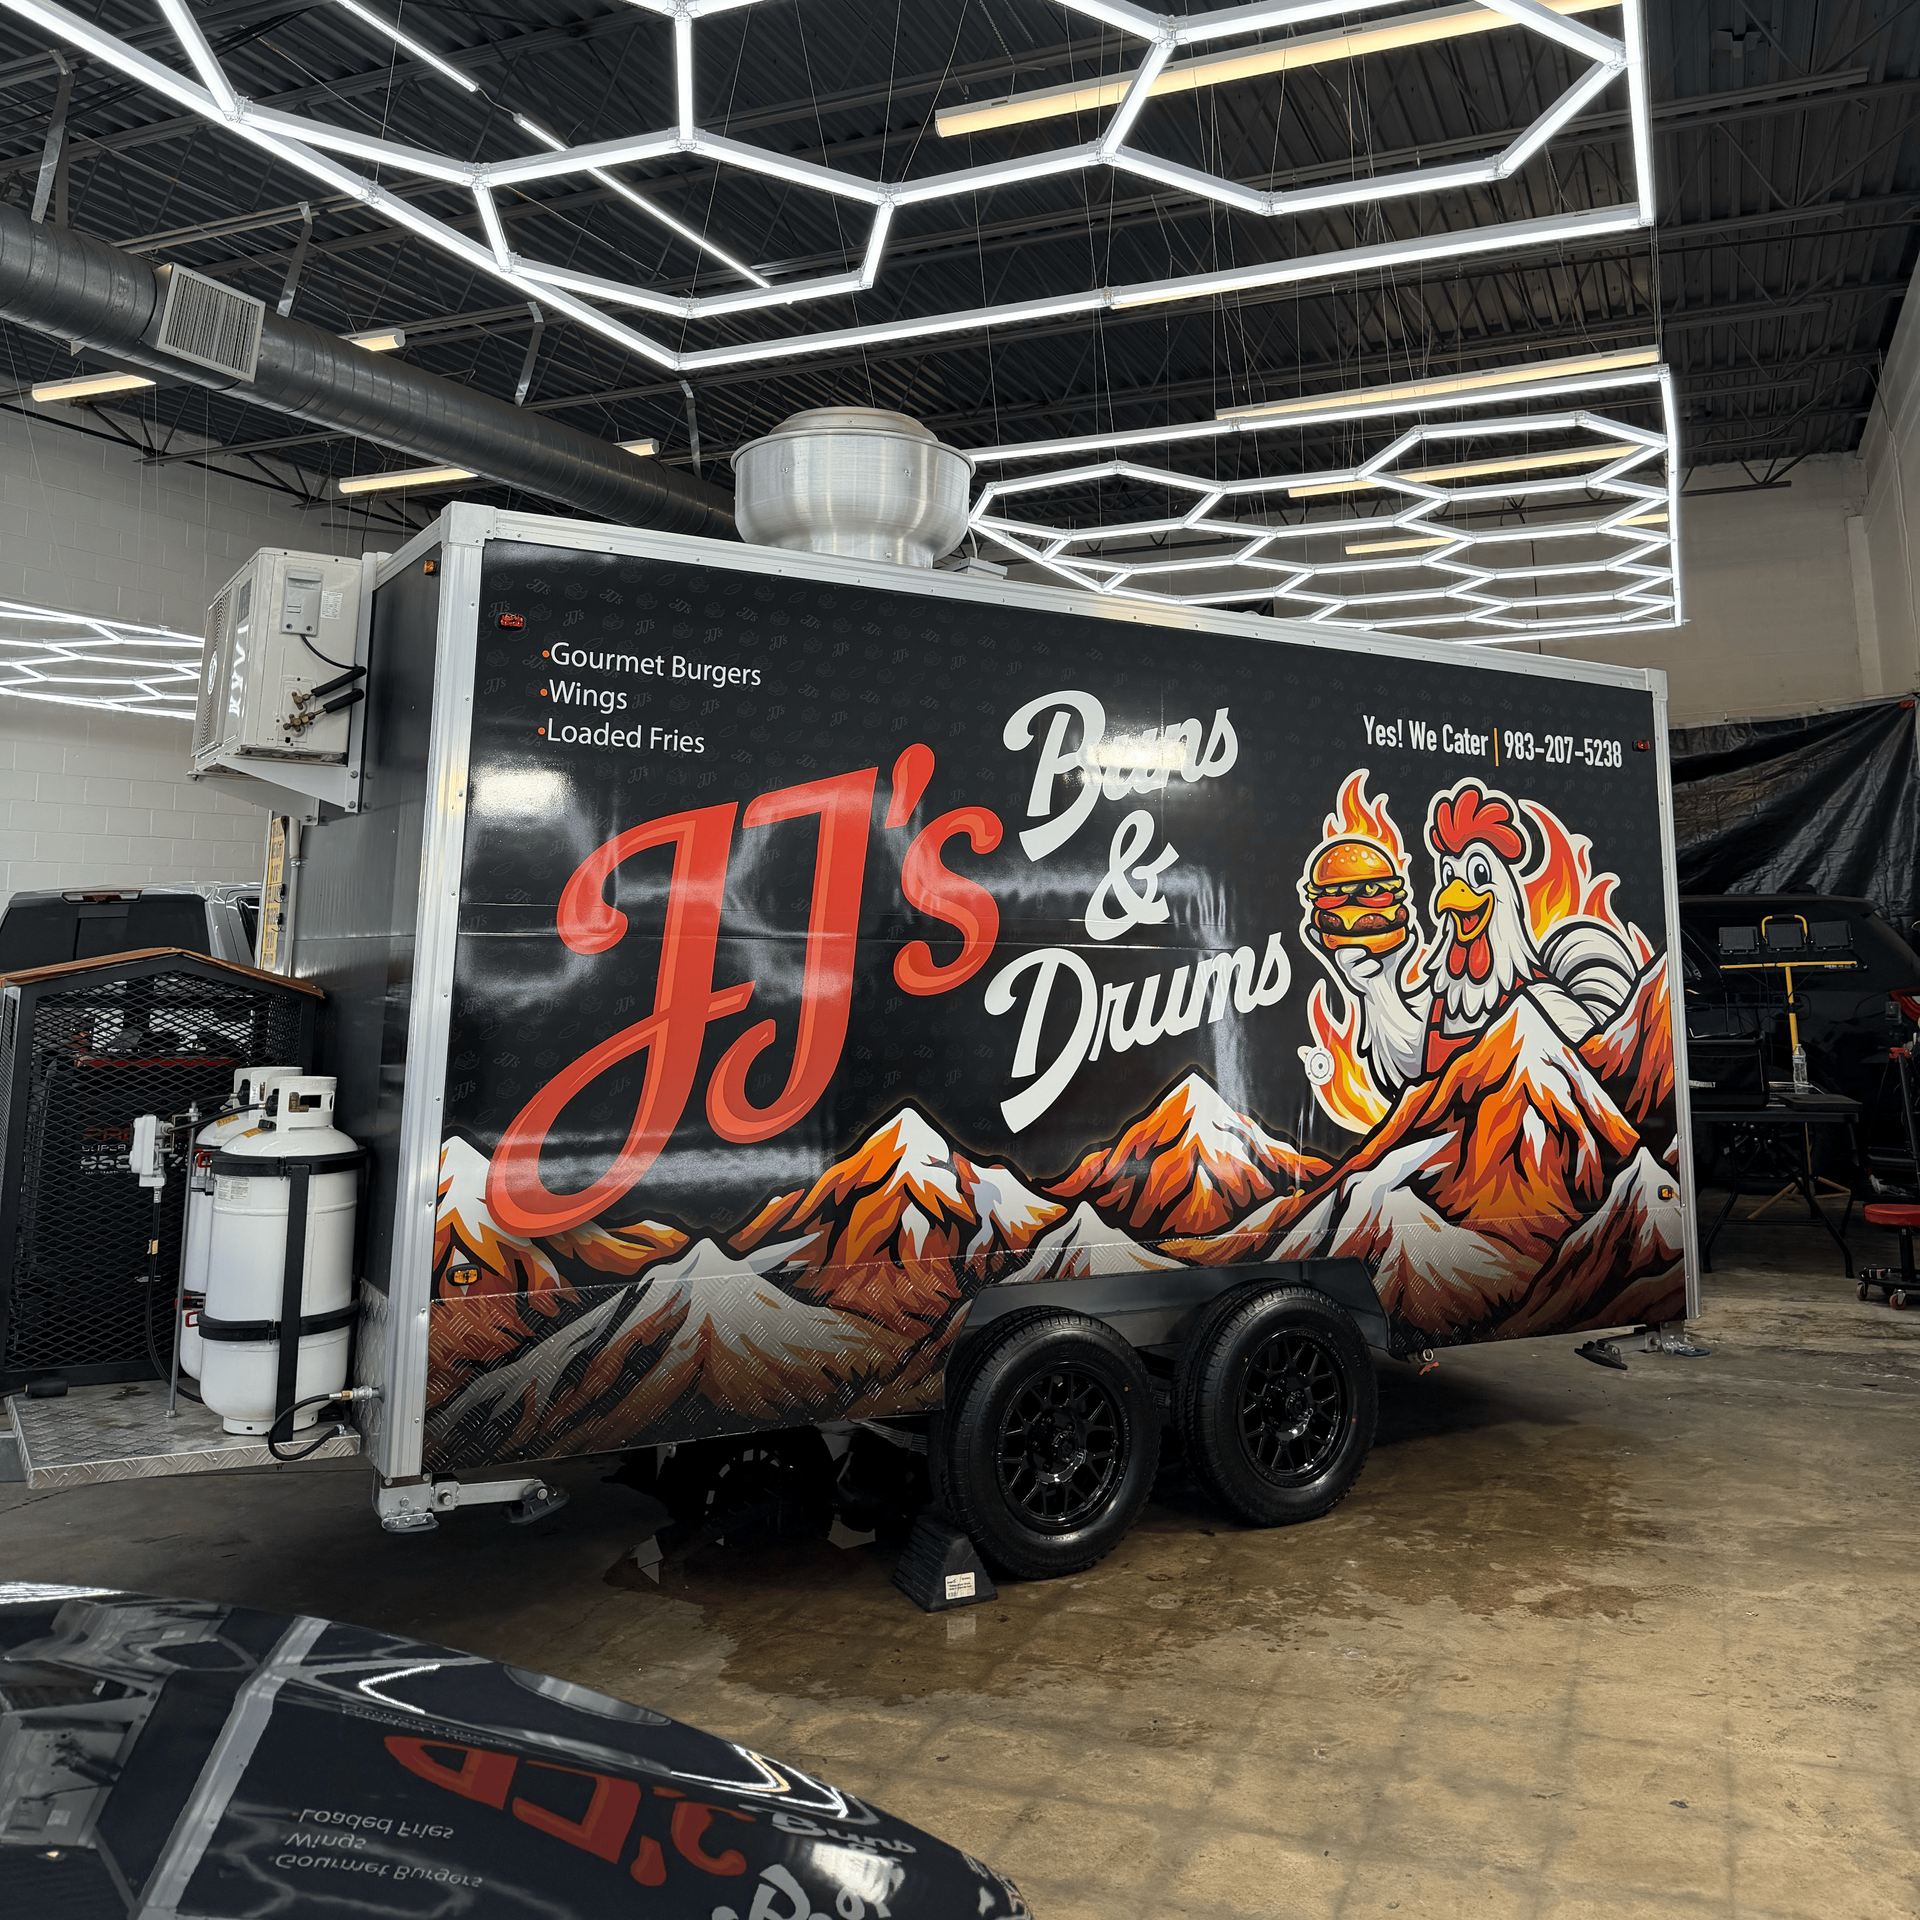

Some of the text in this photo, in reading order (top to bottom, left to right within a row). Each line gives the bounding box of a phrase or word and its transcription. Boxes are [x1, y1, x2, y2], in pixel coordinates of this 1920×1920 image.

[549, 679, 628, 715] Wings
[550, 641, 761, 688] Gourmet Burgers
[547, 717, 705, 754] Loaded Fries
[1003, 689, 1238, 862] Buns
[1362, 714, 1622, 768] Yes! We Cater 983-207-5238
[1084, 809, 1179, 941] &
[486, 743, 1003, 1238] JJ's
[984, 932, 1291, 1135] Drums
